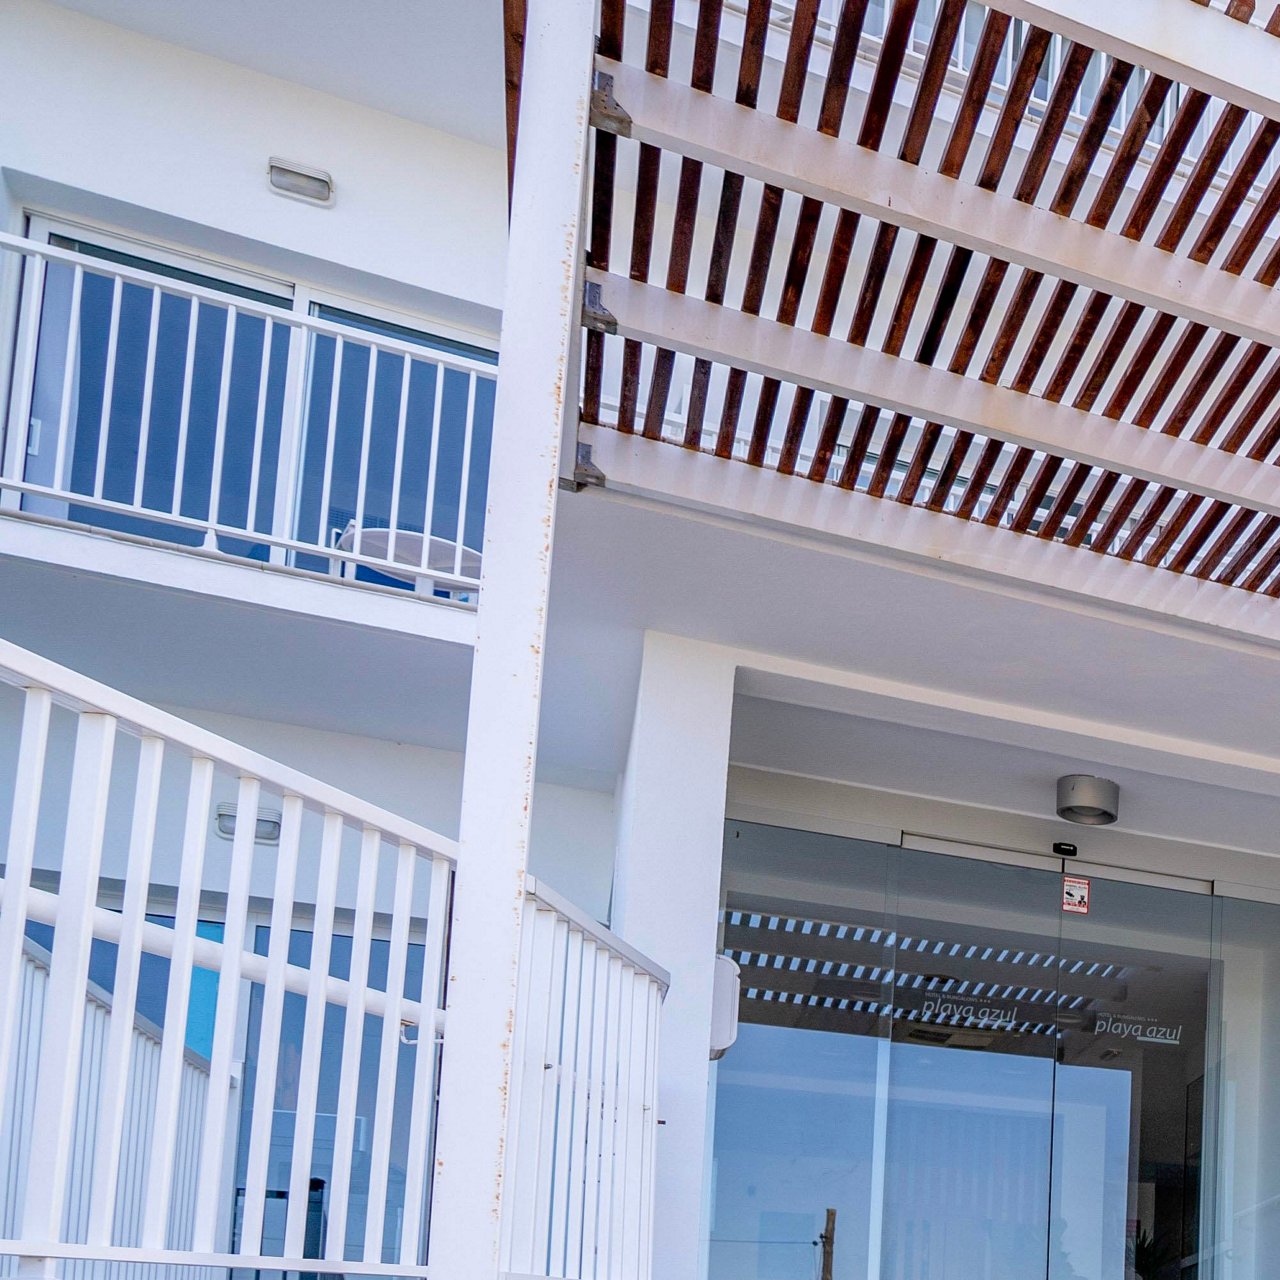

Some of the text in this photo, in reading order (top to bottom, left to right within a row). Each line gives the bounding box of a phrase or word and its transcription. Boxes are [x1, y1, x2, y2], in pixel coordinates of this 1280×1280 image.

[922, 998, 1018, 1022] playa azul
[1094, 1017, 1183, 1041] playa azul
